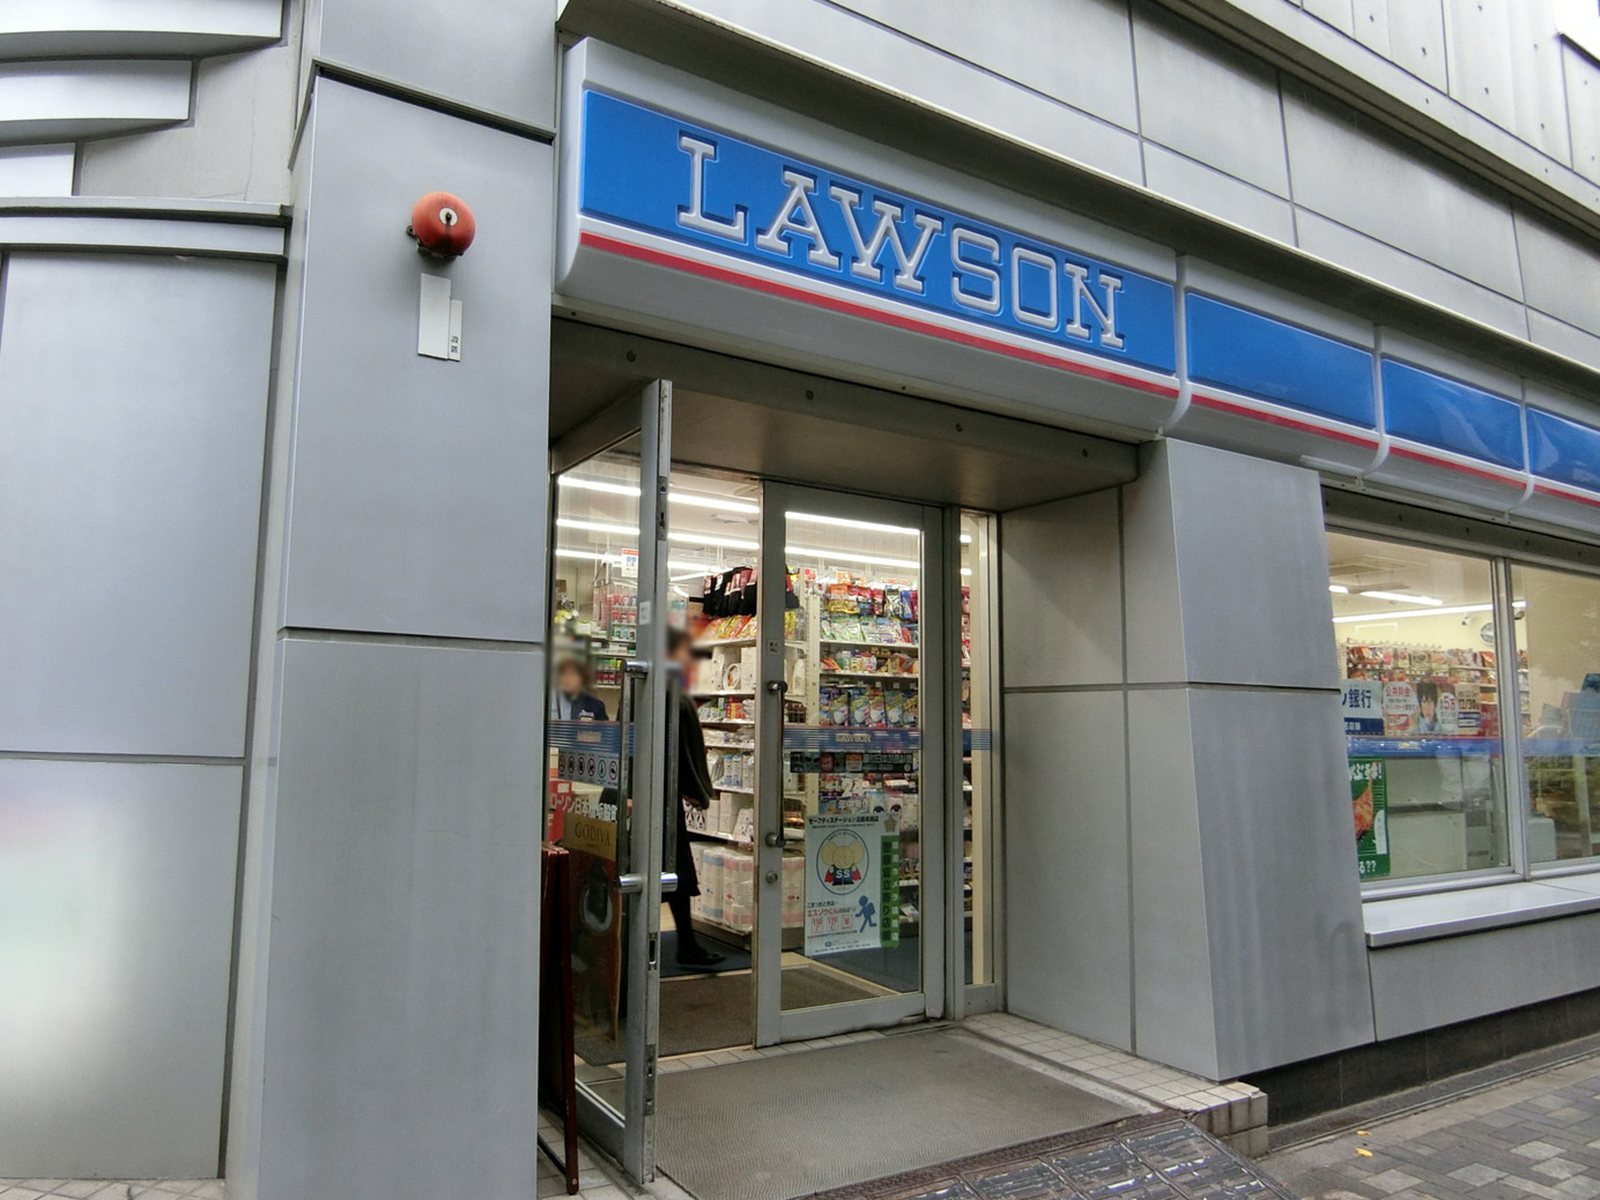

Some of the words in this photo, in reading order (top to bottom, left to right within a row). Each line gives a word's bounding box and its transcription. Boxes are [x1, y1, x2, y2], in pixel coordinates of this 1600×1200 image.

[677, 130, 1126, 351] LAWSON
[574, 821, 611, 847] GODIVA
[835, 869, 850, 878] SS
